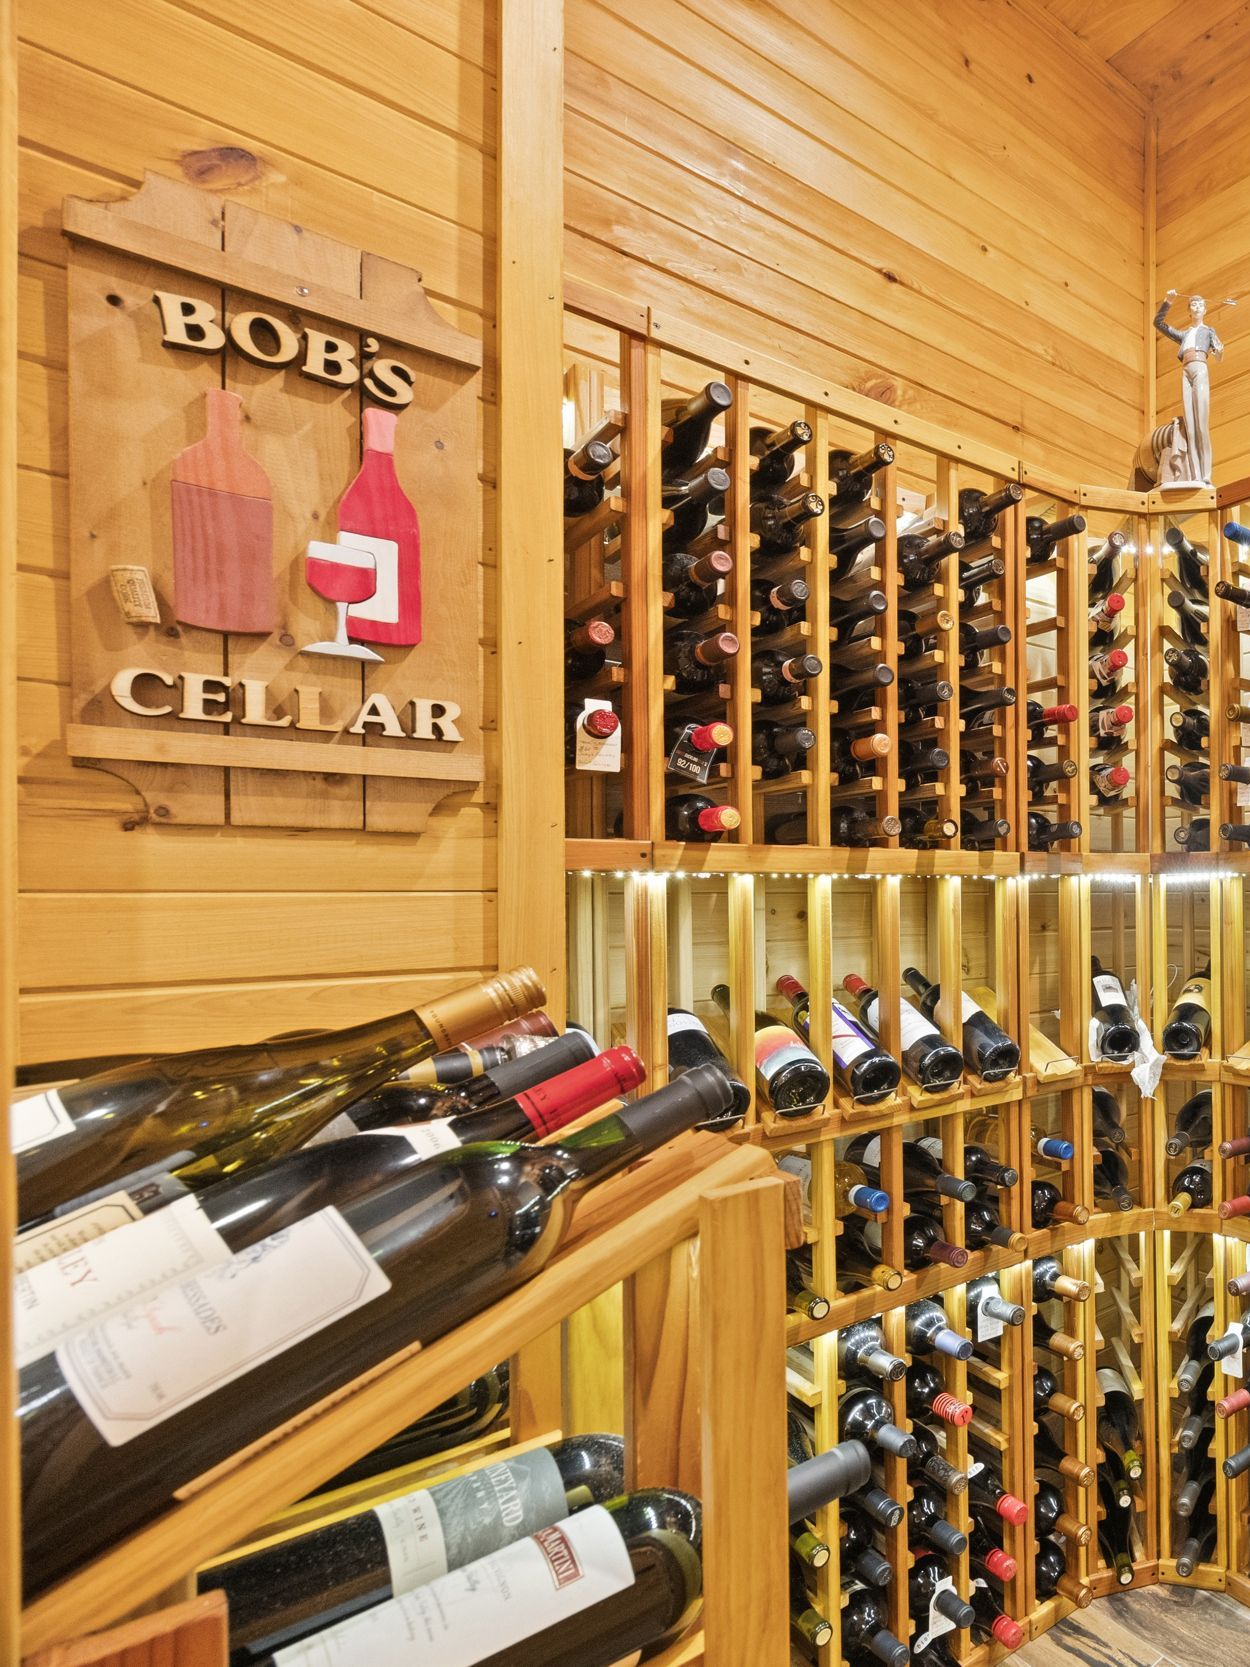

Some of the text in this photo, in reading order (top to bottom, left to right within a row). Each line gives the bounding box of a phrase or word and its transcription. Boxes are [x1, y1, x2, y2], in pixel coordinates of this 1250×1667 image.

[153, 290, 417, 410] BOB'S
[109, 666, 464, 743] CELLAR
[676, 757, 701, 774] 92/100
[411, 1506, 430, 1542] WINE
